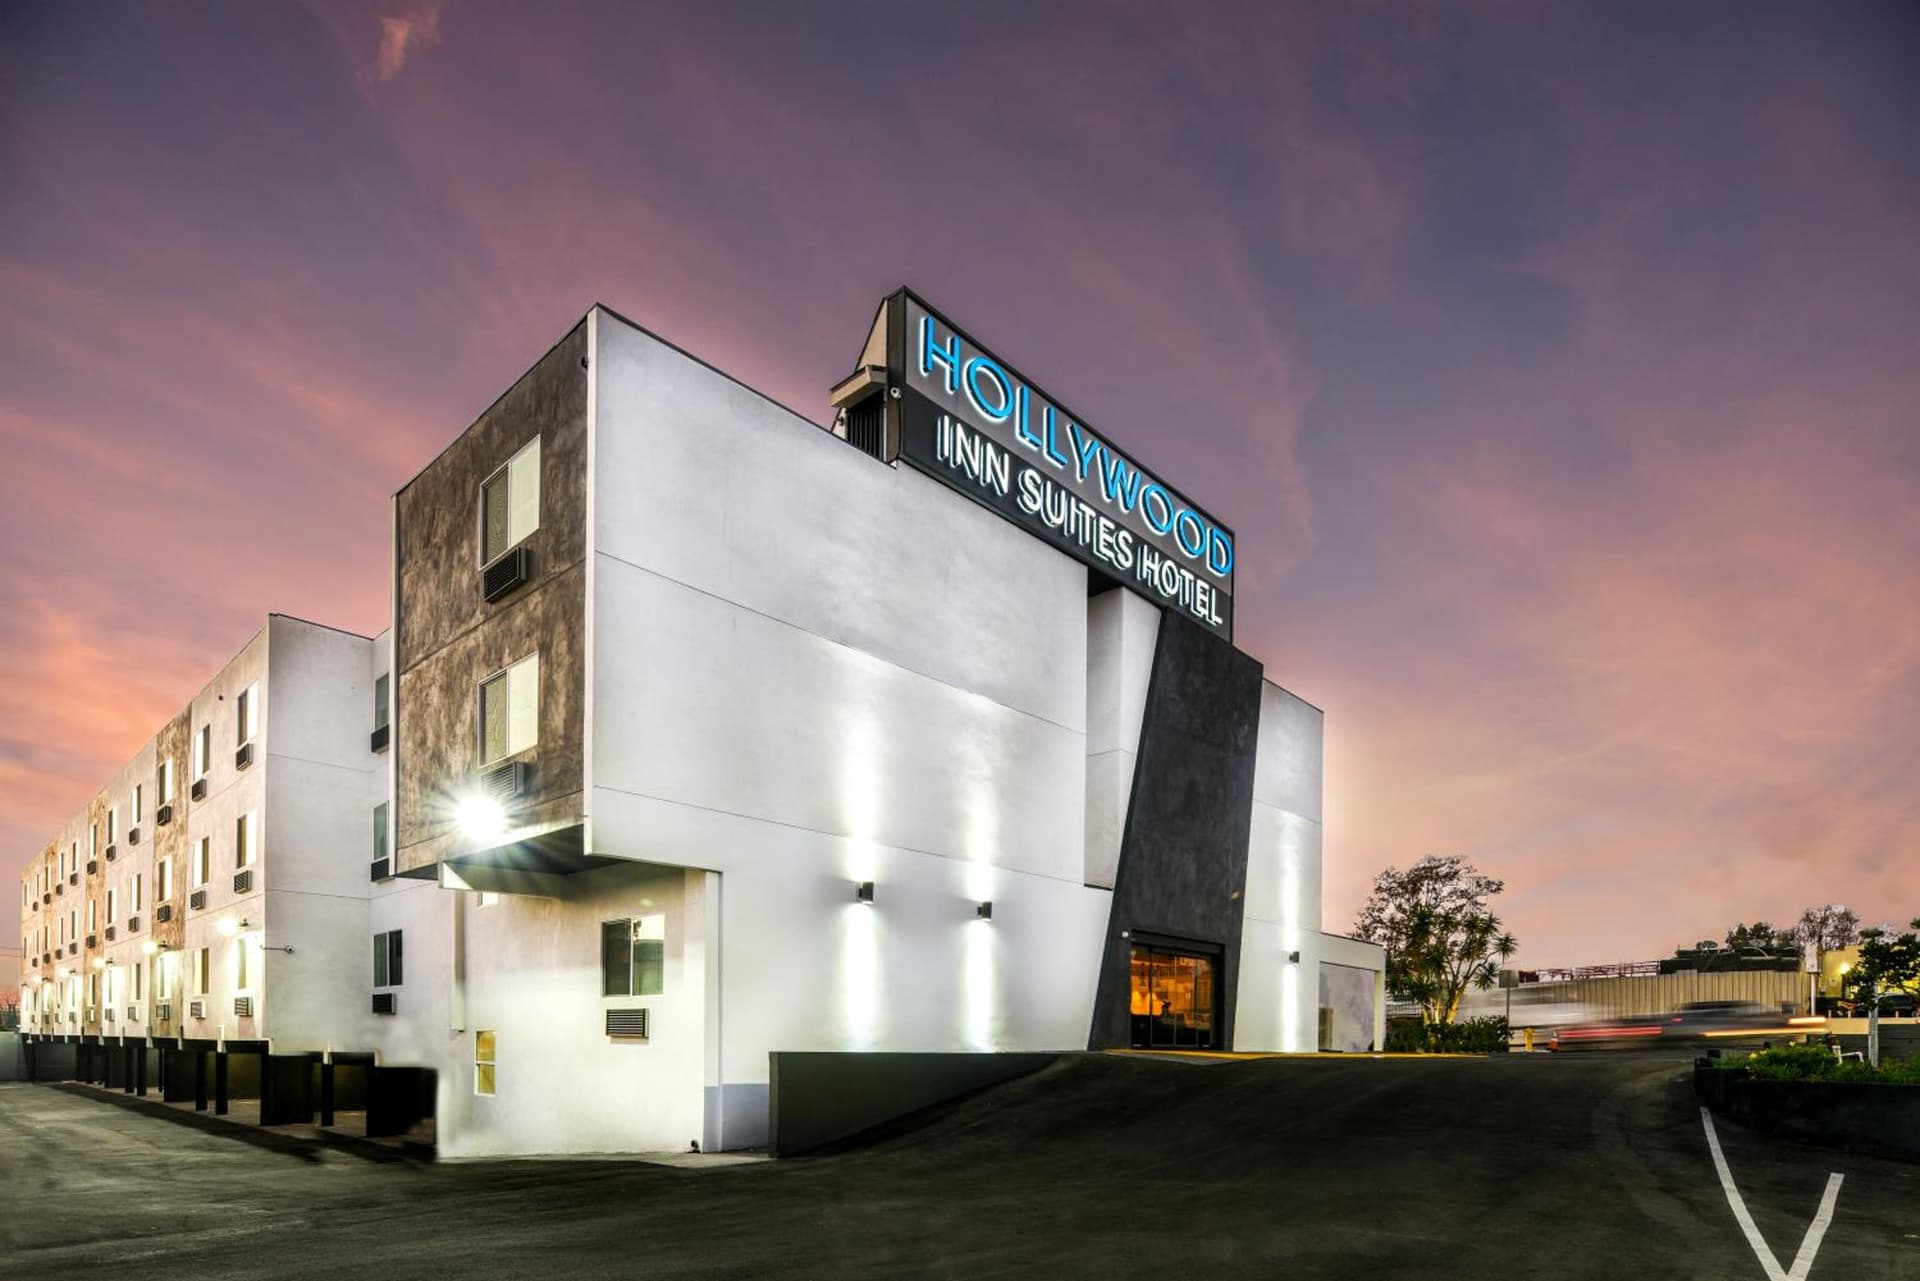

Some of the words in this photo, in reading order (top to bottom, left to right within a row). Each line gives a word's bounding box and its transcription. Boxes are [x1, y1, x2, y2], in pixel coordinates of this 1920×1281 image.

[919, 315, 1234, 577] HOLLYWOOD
[936, 415, 1010, 496] INN
[1016, 469, 1134, 571] SUITES
[1136, 544, 1223, 627] HOTEL
